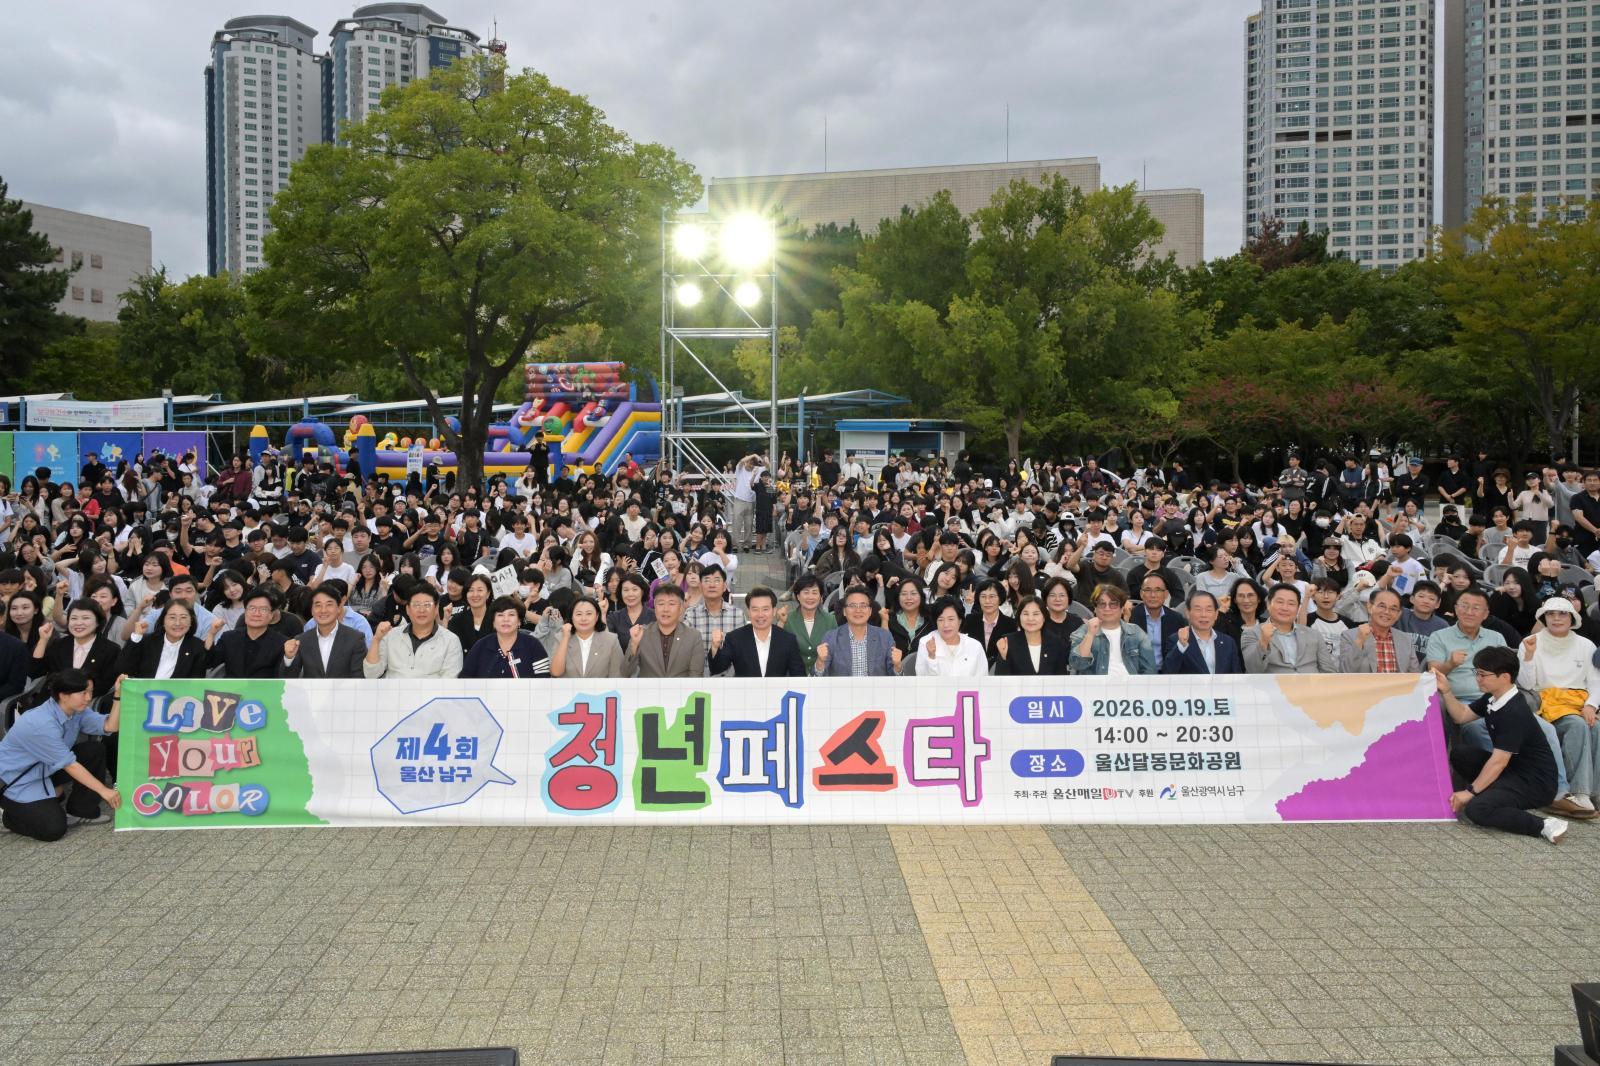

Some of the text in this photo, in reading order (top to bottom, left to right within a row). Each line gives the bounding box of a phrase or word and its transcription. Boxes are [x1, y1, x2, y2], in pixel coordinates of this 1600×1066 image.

[1092, 698, 1231, 717] 2026.09.19.토
[395, 722, 479, 761] 제4회
[1094, 726, 1149, 744] 14:00
[1176, 725, 1234, 743] 20:30
[1095, 751, 1242, 772] 울산달동문화공원
[400, 766, 473, 783] 울산 남구
[1138, 785, 1245, 798] 후원 울산광역시 남구
